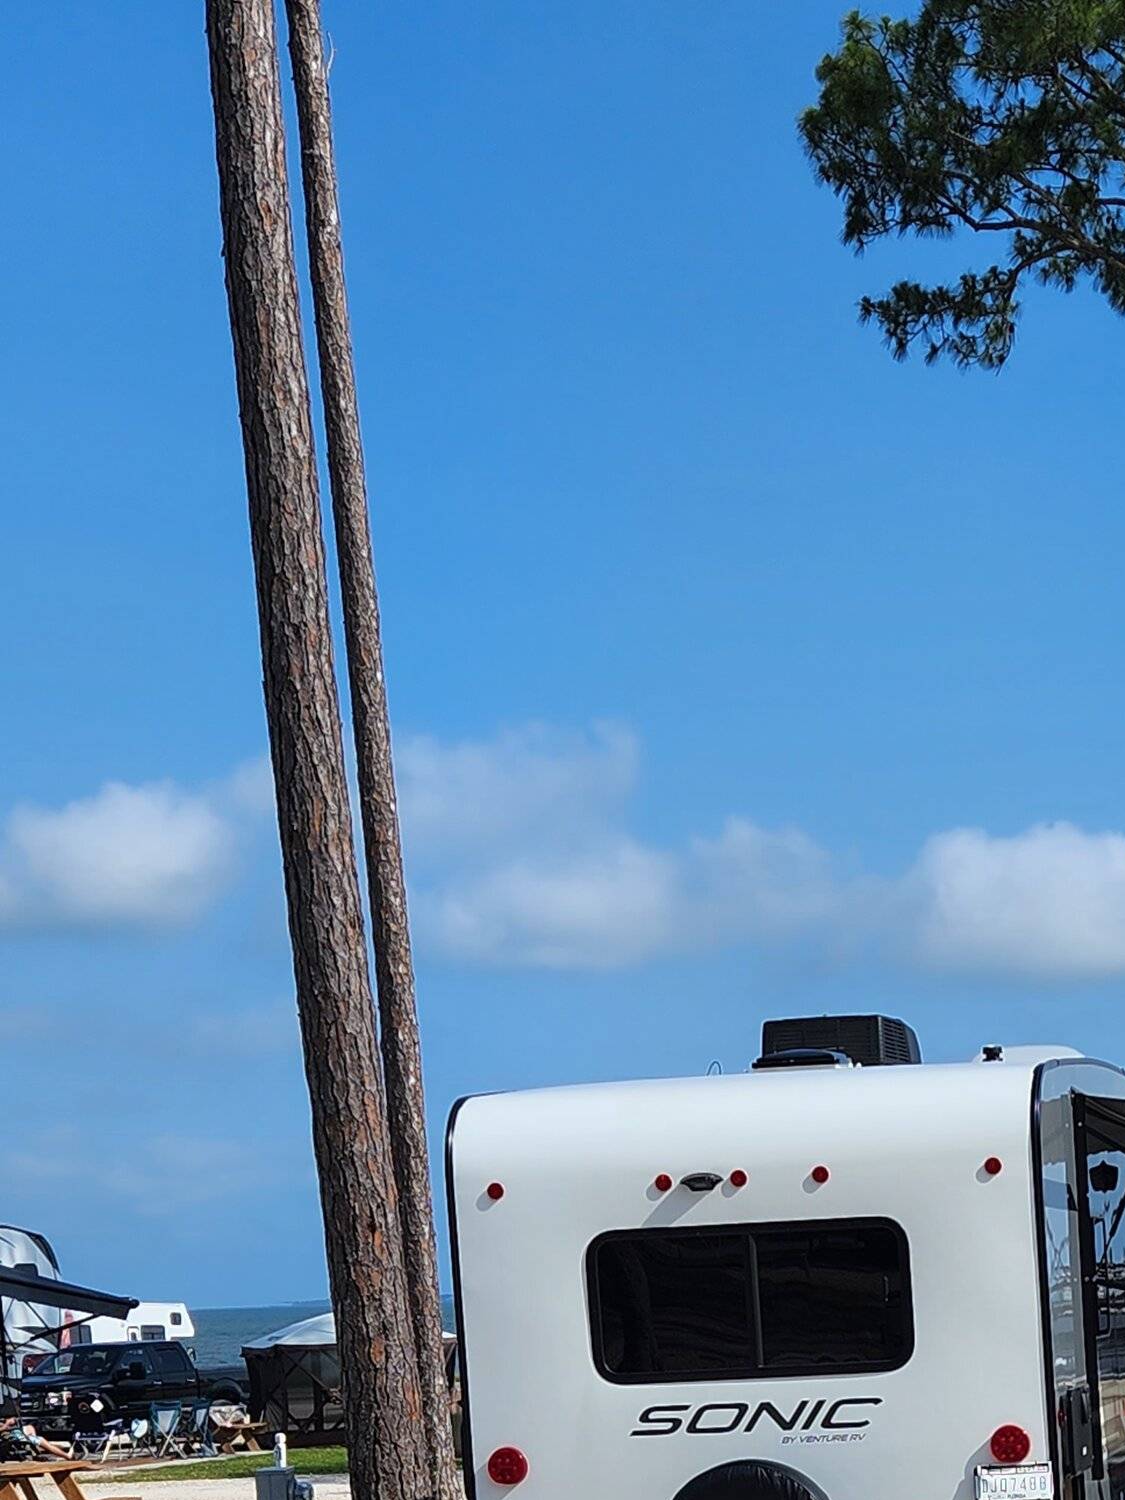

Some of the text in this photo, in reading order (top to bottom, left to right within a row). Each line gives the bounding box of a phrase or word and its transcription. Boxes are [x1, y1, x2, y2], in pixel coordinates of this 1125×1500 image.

[630, 1397, 884, 1437] SONIC
[781, 1433, 867, 1444] BY VENTURE RV
